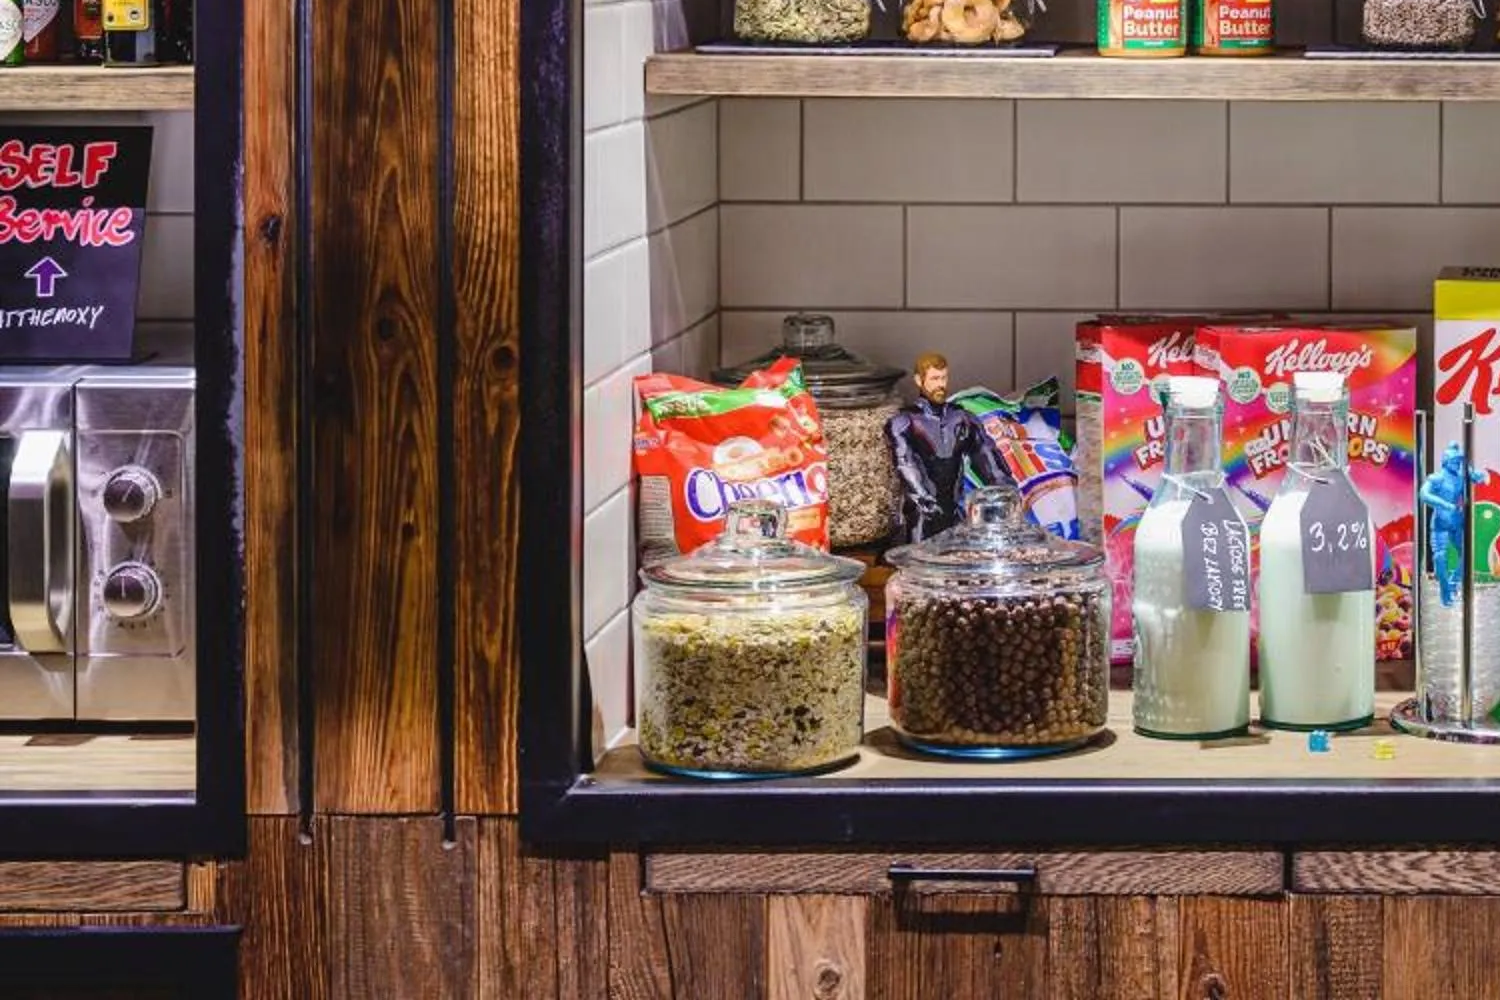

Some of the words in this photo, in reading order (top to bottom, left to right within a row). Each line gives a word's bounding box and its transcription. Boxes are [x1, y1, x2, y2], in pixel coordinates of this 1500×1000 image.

[1124, 5, 1179, 19] Peanut
[1219, 5, 1271, 19] Peanut
[1219, 21, 1271, 35] Butter
[1124, 21, 1178, 36] Butter
[0, 140, 118, 190] SELF
[0, 195, 134, 246] Service
[1264, 338, 1373, 378] Kellogg's
[1200, 522, 1219, 555] BEZ
[1309, 521, 1367, 553] 3,2%
